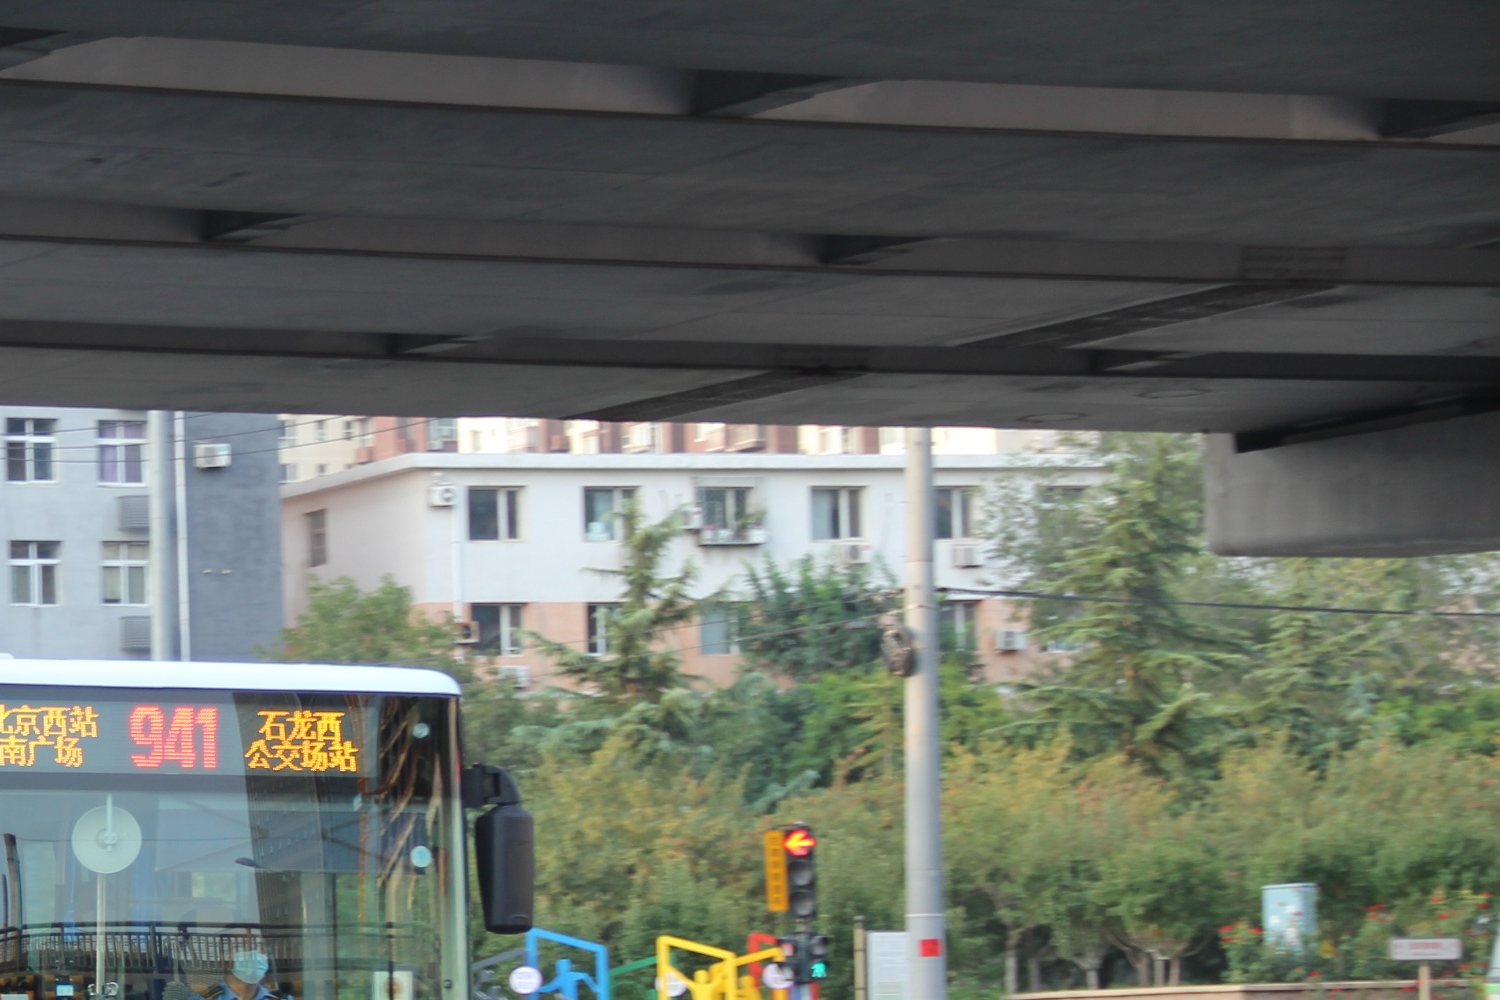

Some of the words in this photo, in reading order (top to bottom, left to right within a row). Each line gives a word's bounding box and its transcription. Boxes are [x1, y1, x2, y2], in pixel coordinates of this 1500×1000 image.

[128, 704, 220, 769] 941
[256, 709, 347, 743] 石龙西
[244, 739, 360, 773] 公交场站
